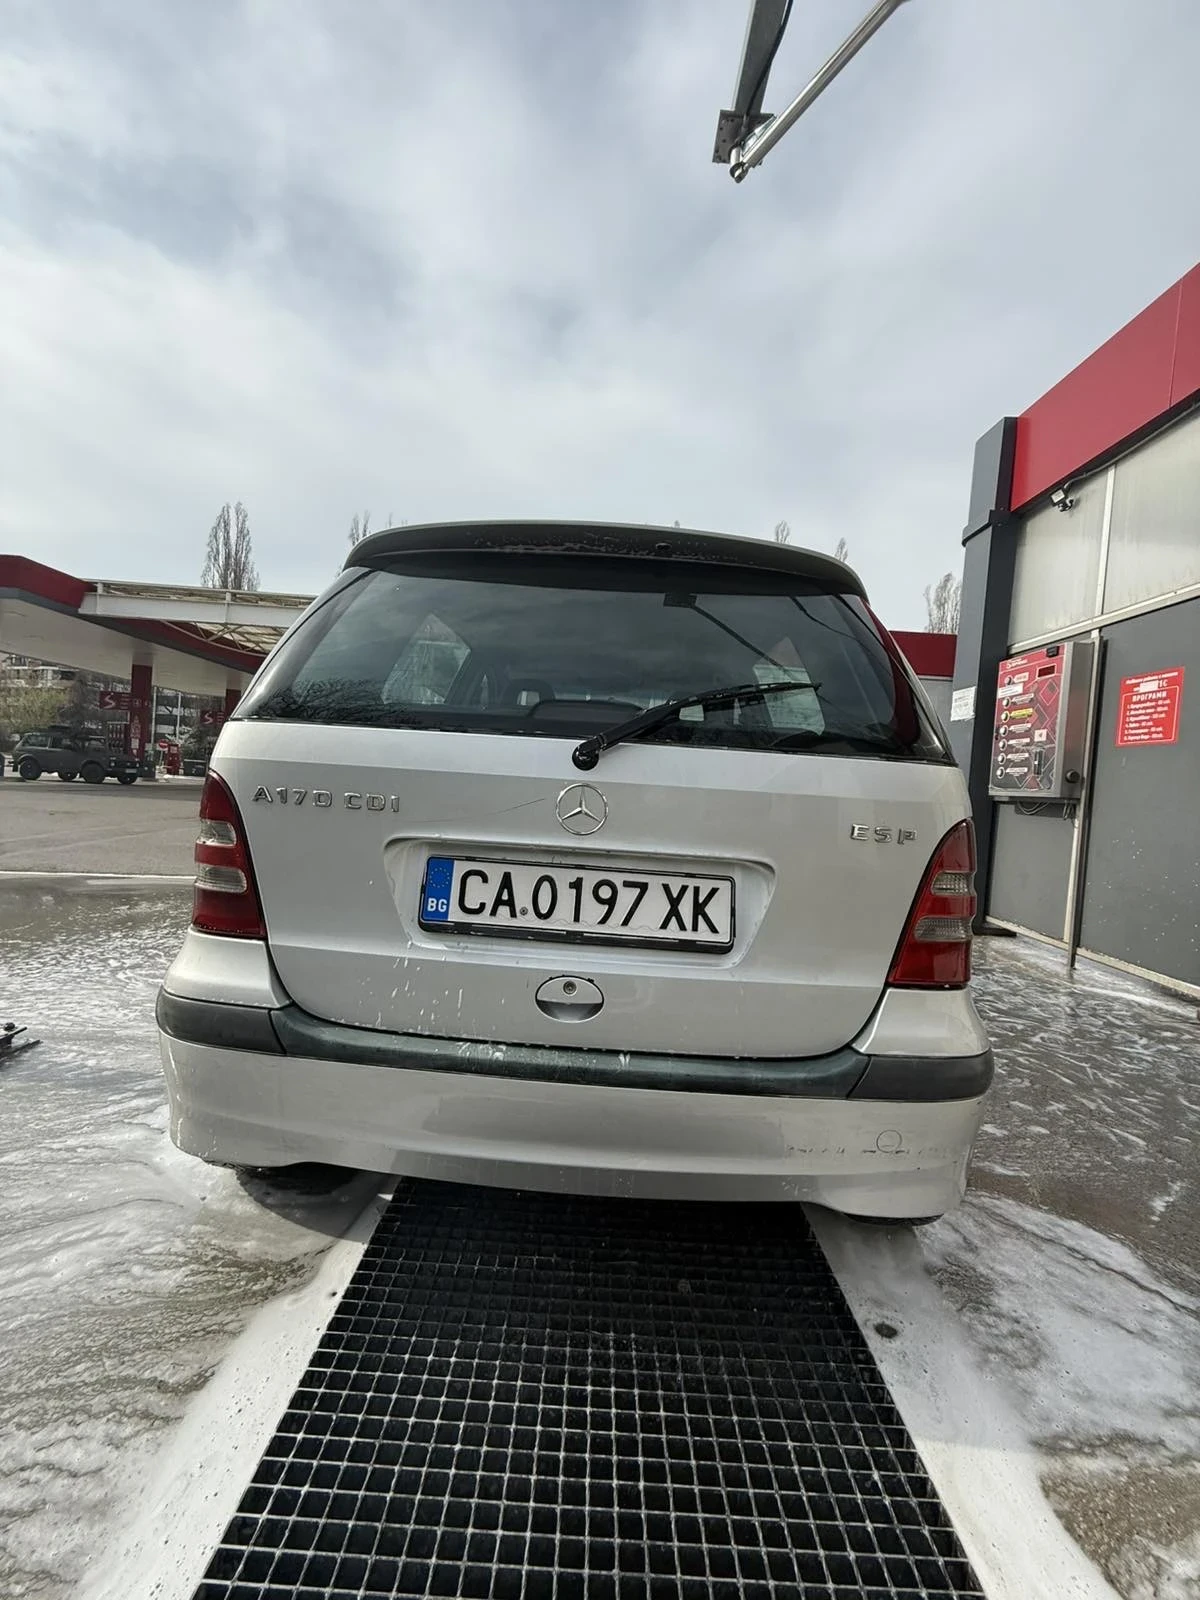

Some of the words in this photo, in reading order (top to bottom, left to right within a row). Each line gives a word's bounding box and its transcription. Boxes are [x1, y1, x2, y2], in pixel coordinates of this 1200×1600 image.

[343, 792, 401, 813] CDI
[850, 823, 918, 846] ESP
[427, 897, 448, 913] BG
[458, 869, 518, 918] CA
[531, 873, 650, 927] 0197
[658, 882, 721, 934] XK
